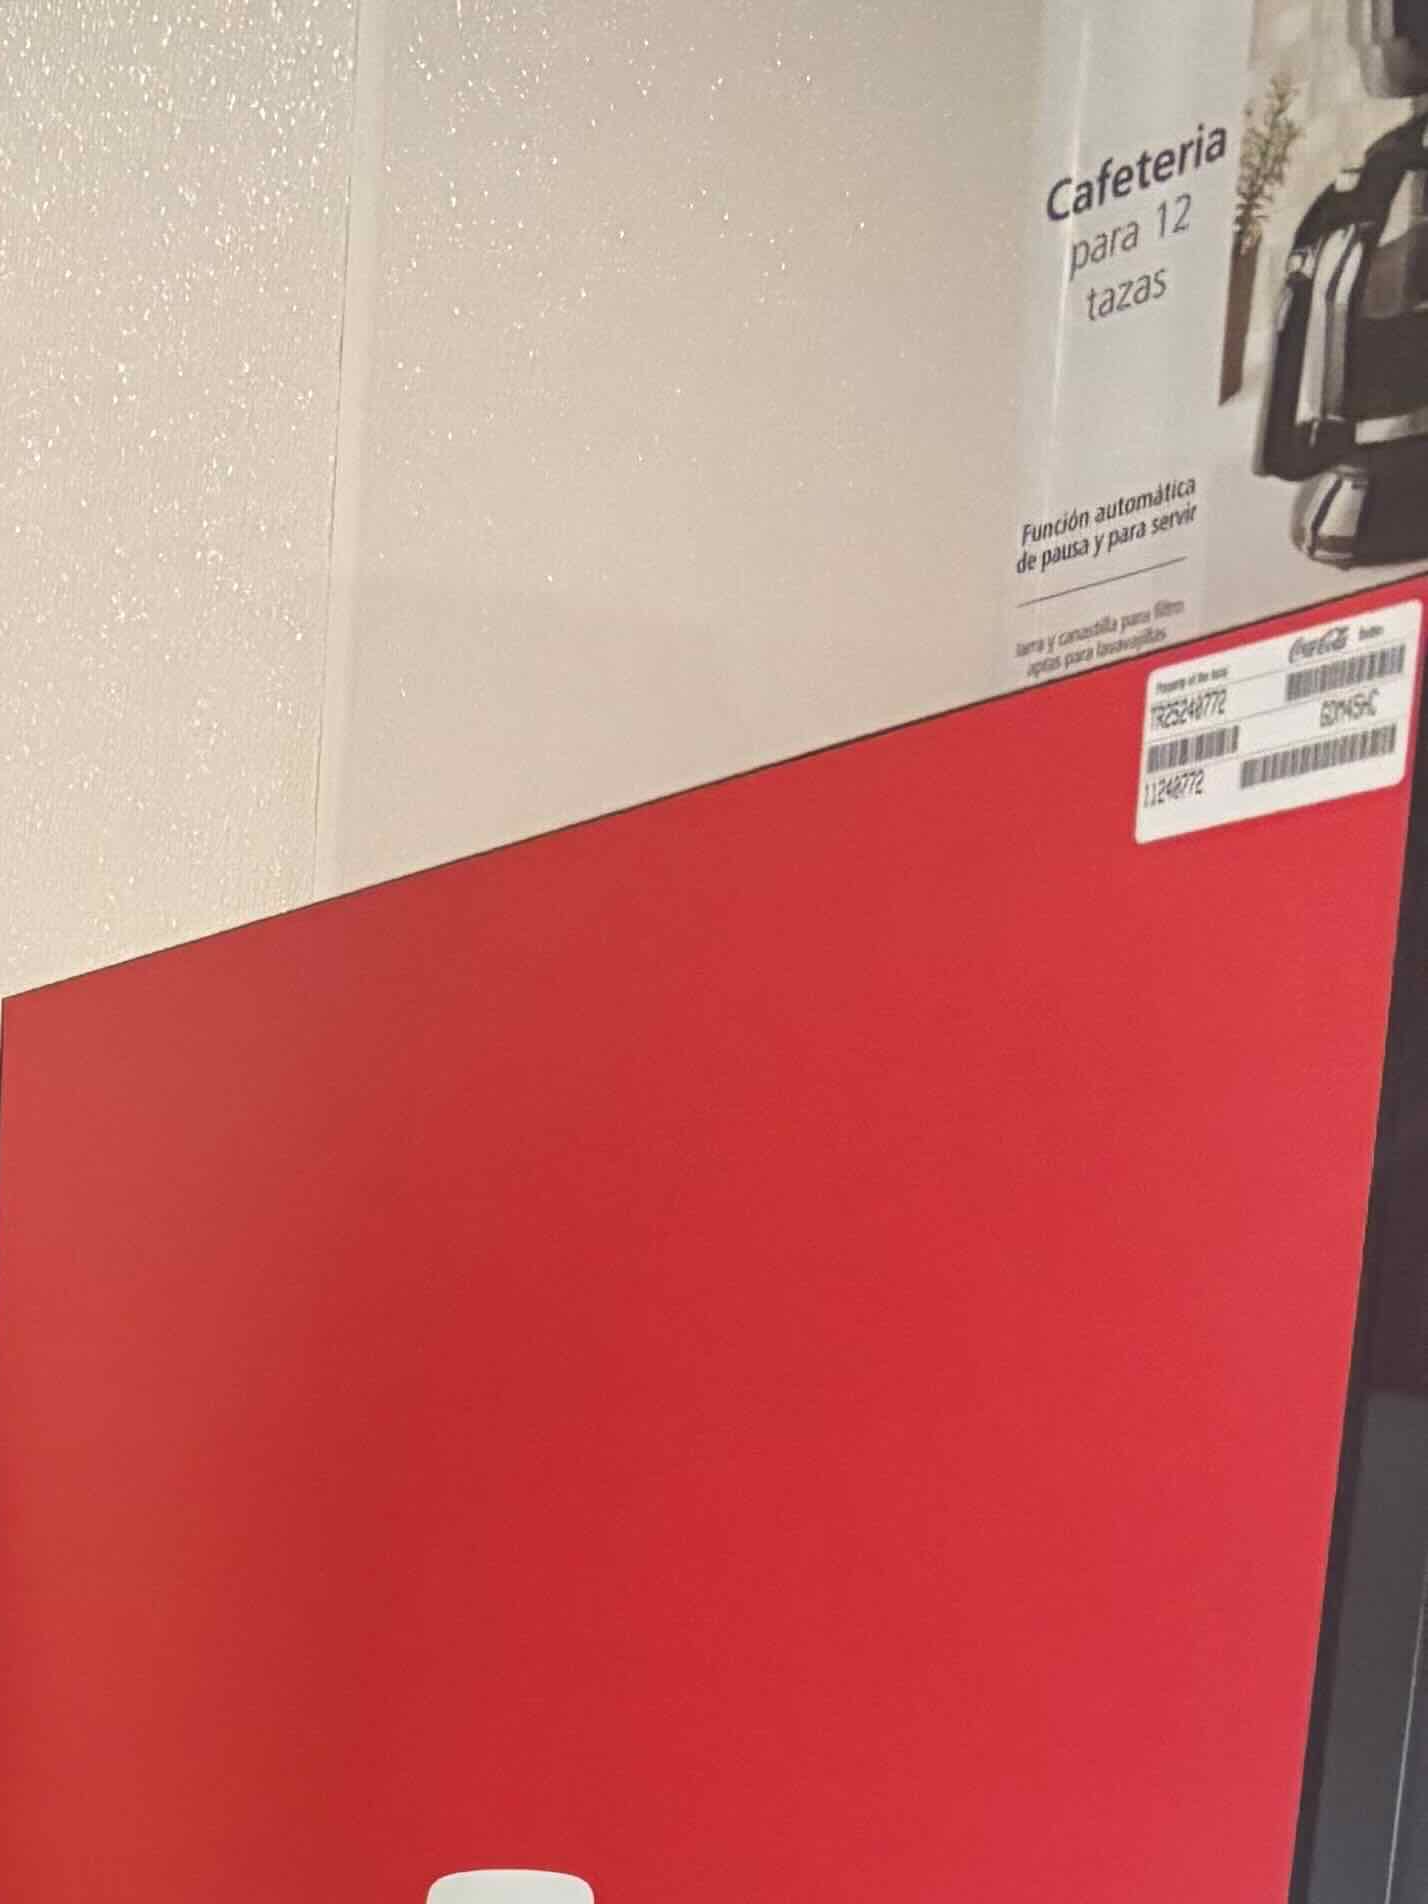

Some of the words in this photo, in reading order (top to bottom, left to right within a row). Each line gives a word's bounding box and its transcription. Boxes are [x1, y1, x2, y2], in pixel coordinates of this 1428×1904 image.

[1046, 122, 1227, 222] Cafeteria
[1070, 221, 1140, 280] para
[1157, 194, 1193, 238] 12
[1087, 268, 1169, 321] tazas
[1016, 552, 1037, 575] de
[1041, 535, 1090, 573] pausa
[1092, 533, 1106, 558] y
[1107, 520, 1147, 553] para
[1151, 502, 1199, 535] servir
[1021, 508, 1090, 547] Función
[1094, 477, 1197, 523] automática
